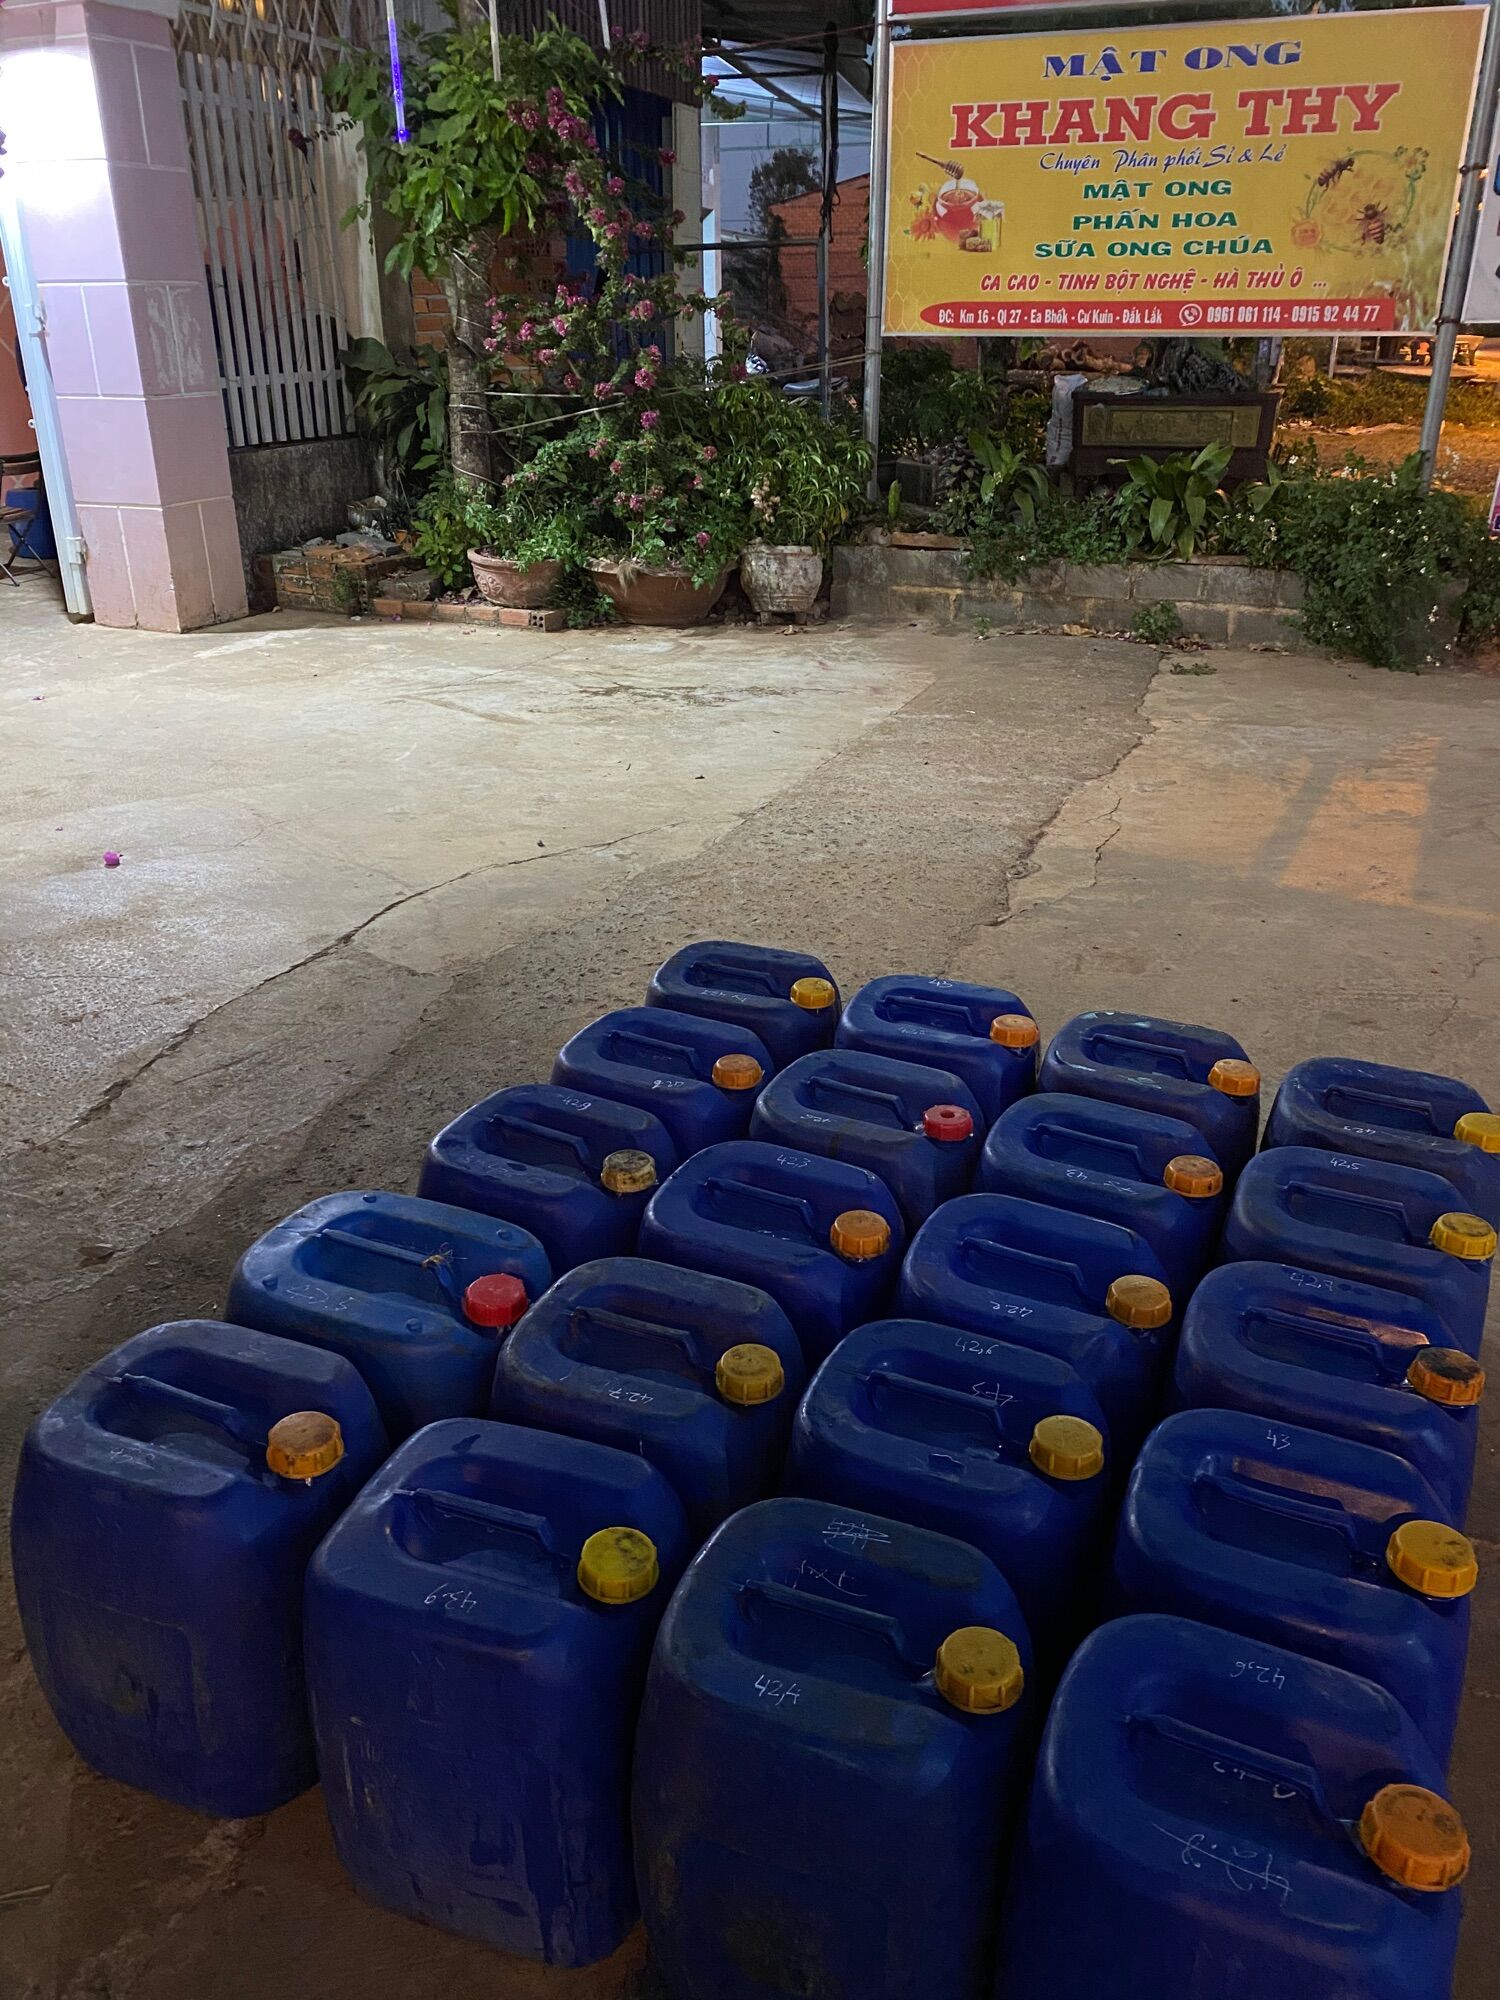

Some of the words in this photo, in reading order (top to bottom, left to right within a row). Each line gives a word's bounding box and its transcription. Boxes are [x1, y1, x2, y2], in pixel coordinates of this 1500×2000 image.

[1043, 46, 1167, 81] MẬT
[1184, 41, 1302, 70] ONG
[950, 91, 1216, 149] KHANG
[1237, 81, 1402, 138] THY
[1040, 152, 1100, 175] Chuyên
[1113, 150, 1158, 173] Phân
[1162, 147, 1202, 174] phối
[1238, 148, 1253, 163] &
[1083, 180, 1152, 201] MẬT
[1165, 180, 1232, 196] ONG
[1073, 208, 1159, 230] PHẤN
[1171, 211, 1238, 228] HOA
[1034, 240, 1096, 258] SỮA
[1107, 241, 1171, 256] ONG
[1183, 235, 1273, 255] CHÚA
[980, 274, 1001, 291] CA
[1007, 274, 1040, 291] CAO
[1058, 273, 1100, 290] TINH
[1104, 269, 1140, 294] BỘT
[1143, 267, 1197, 294] NGHỆ
[1213, 267, 1239, 289] HÀ
[1289, 266, 1304, 288] Ô
[938, 308, 955, 324] ĐC:
[959, 308, 975, 324] Km
[977, 308, 990, 324] 16
[1009, 308, 1022, 324] 27
[1030, 308, 1042, 324] Ea
[1092, 308, 1114, 324] Kuin
[1207, 306, 1235, 323] 0961
[1262, 306, 1281, 323] 114
[1291, 306, 1320, 323] 0915
[1323, 305, 1338, 322] 92
[1343, 305, 1360, 322] 44
[1363, 304, 1381, 322] 77
[1266, 1429, 1292, 1451] 43
